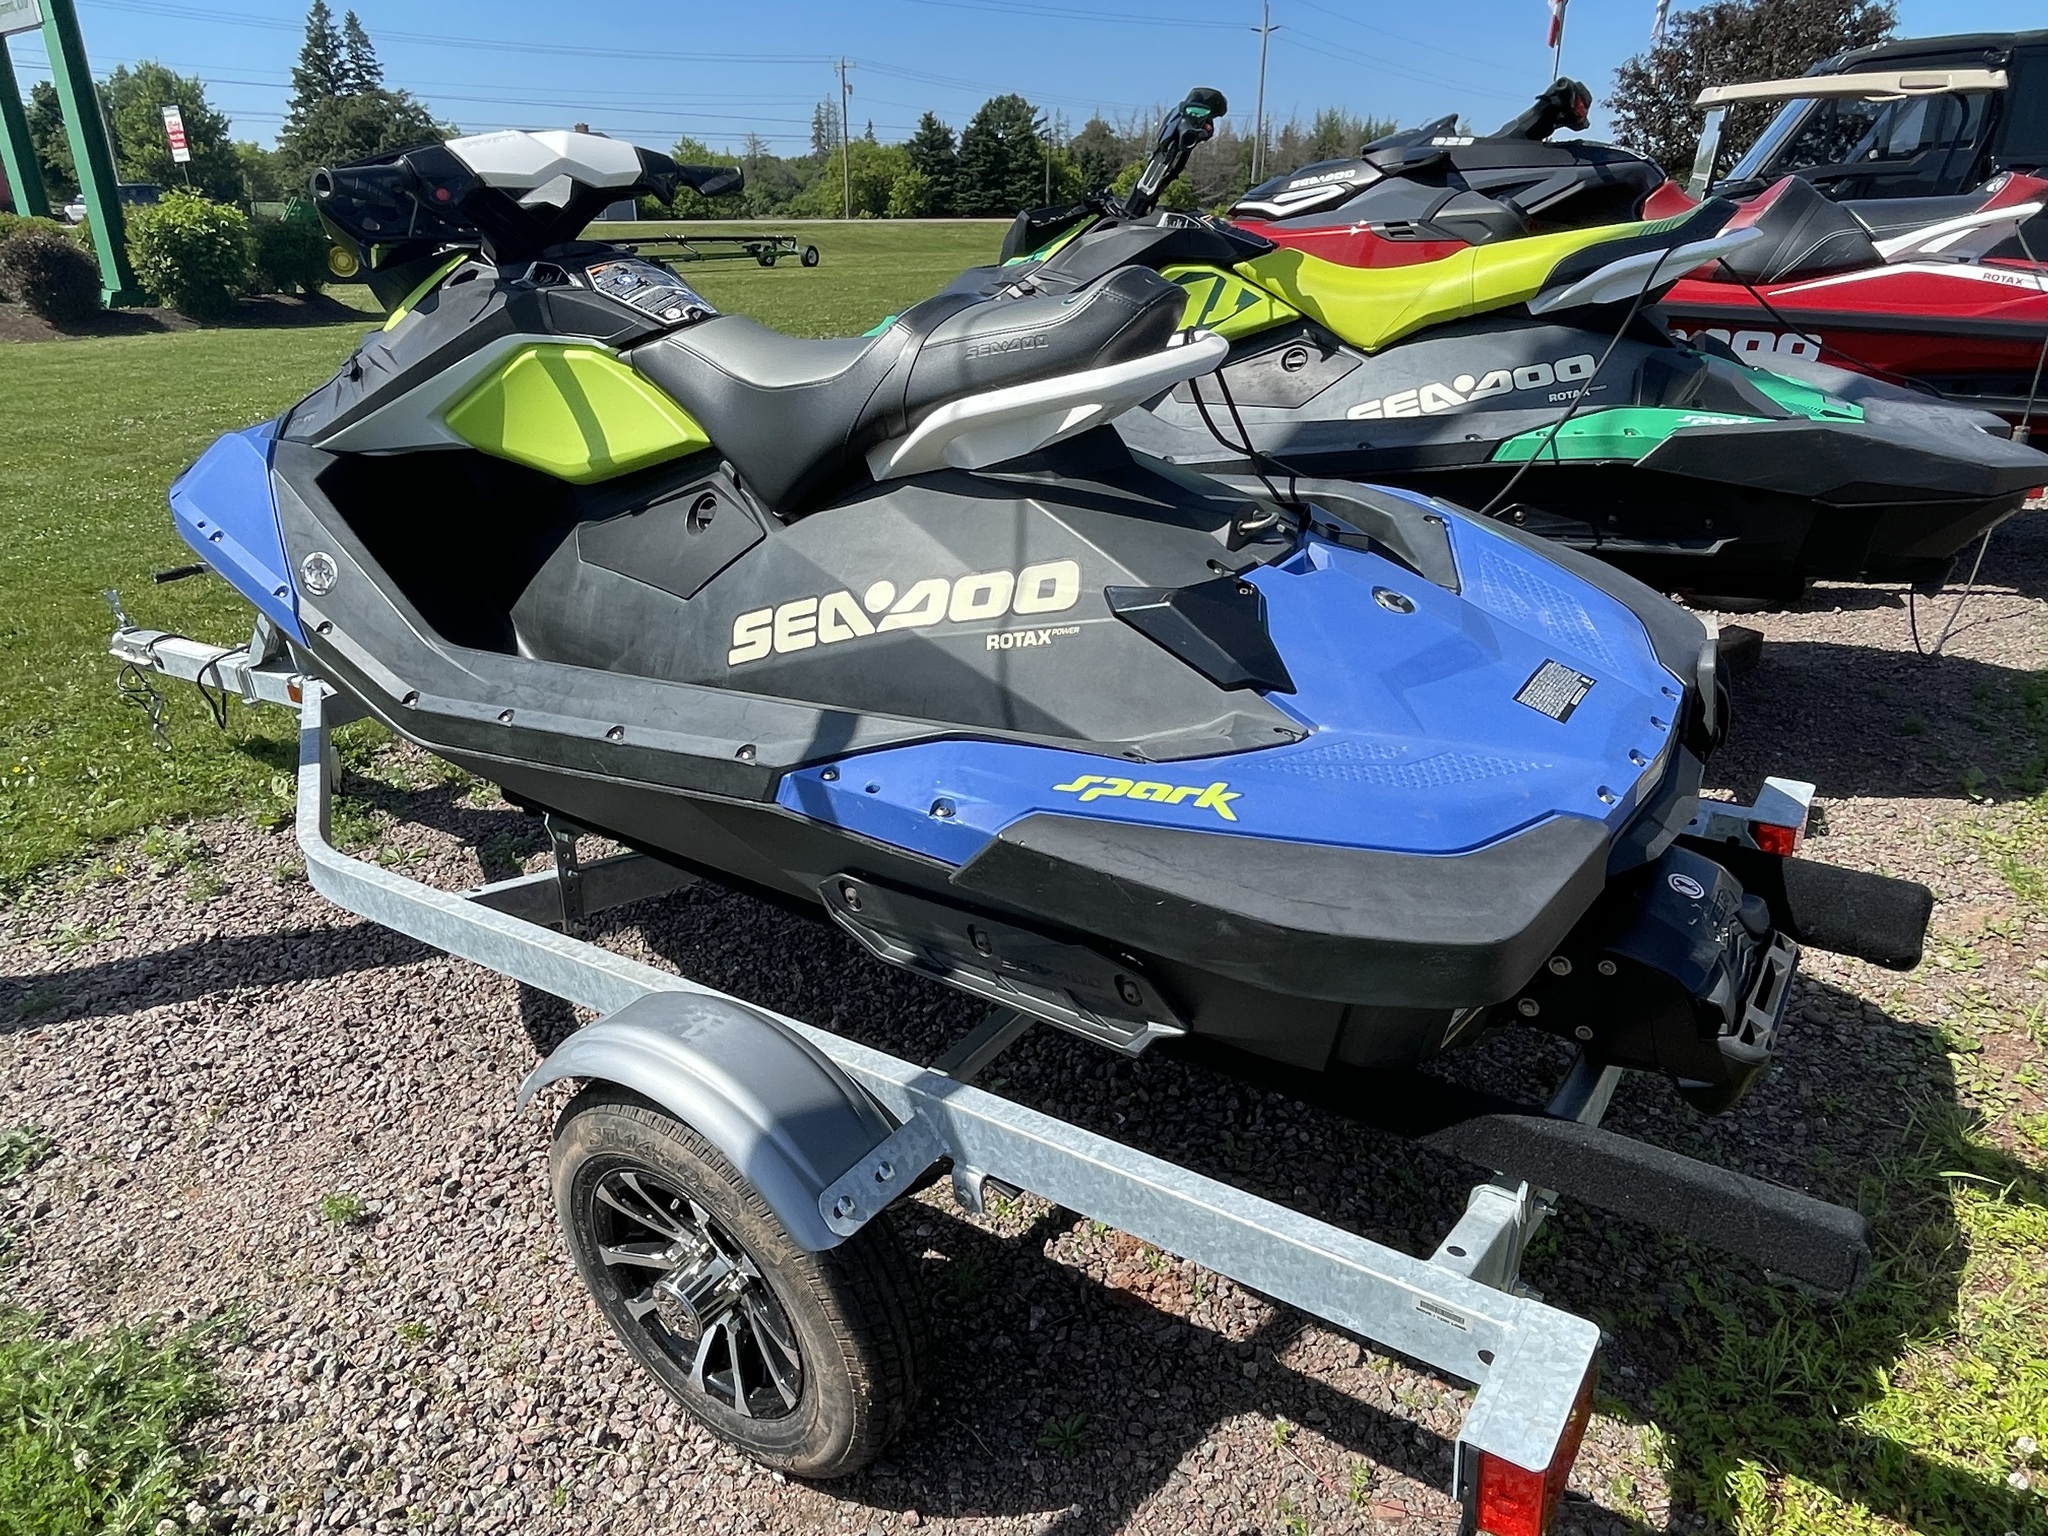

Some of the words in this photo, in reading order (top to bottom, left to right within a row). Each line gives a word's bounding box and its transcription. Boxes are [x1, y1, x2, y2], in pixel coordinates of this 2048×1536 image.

[1982, 272, 2024, 285] ROTAX
[986, 629, 1052, 651] ROTAX
[1052, 626, 1081, 636] POWER
[1053, 775, 1242, 821] spark
